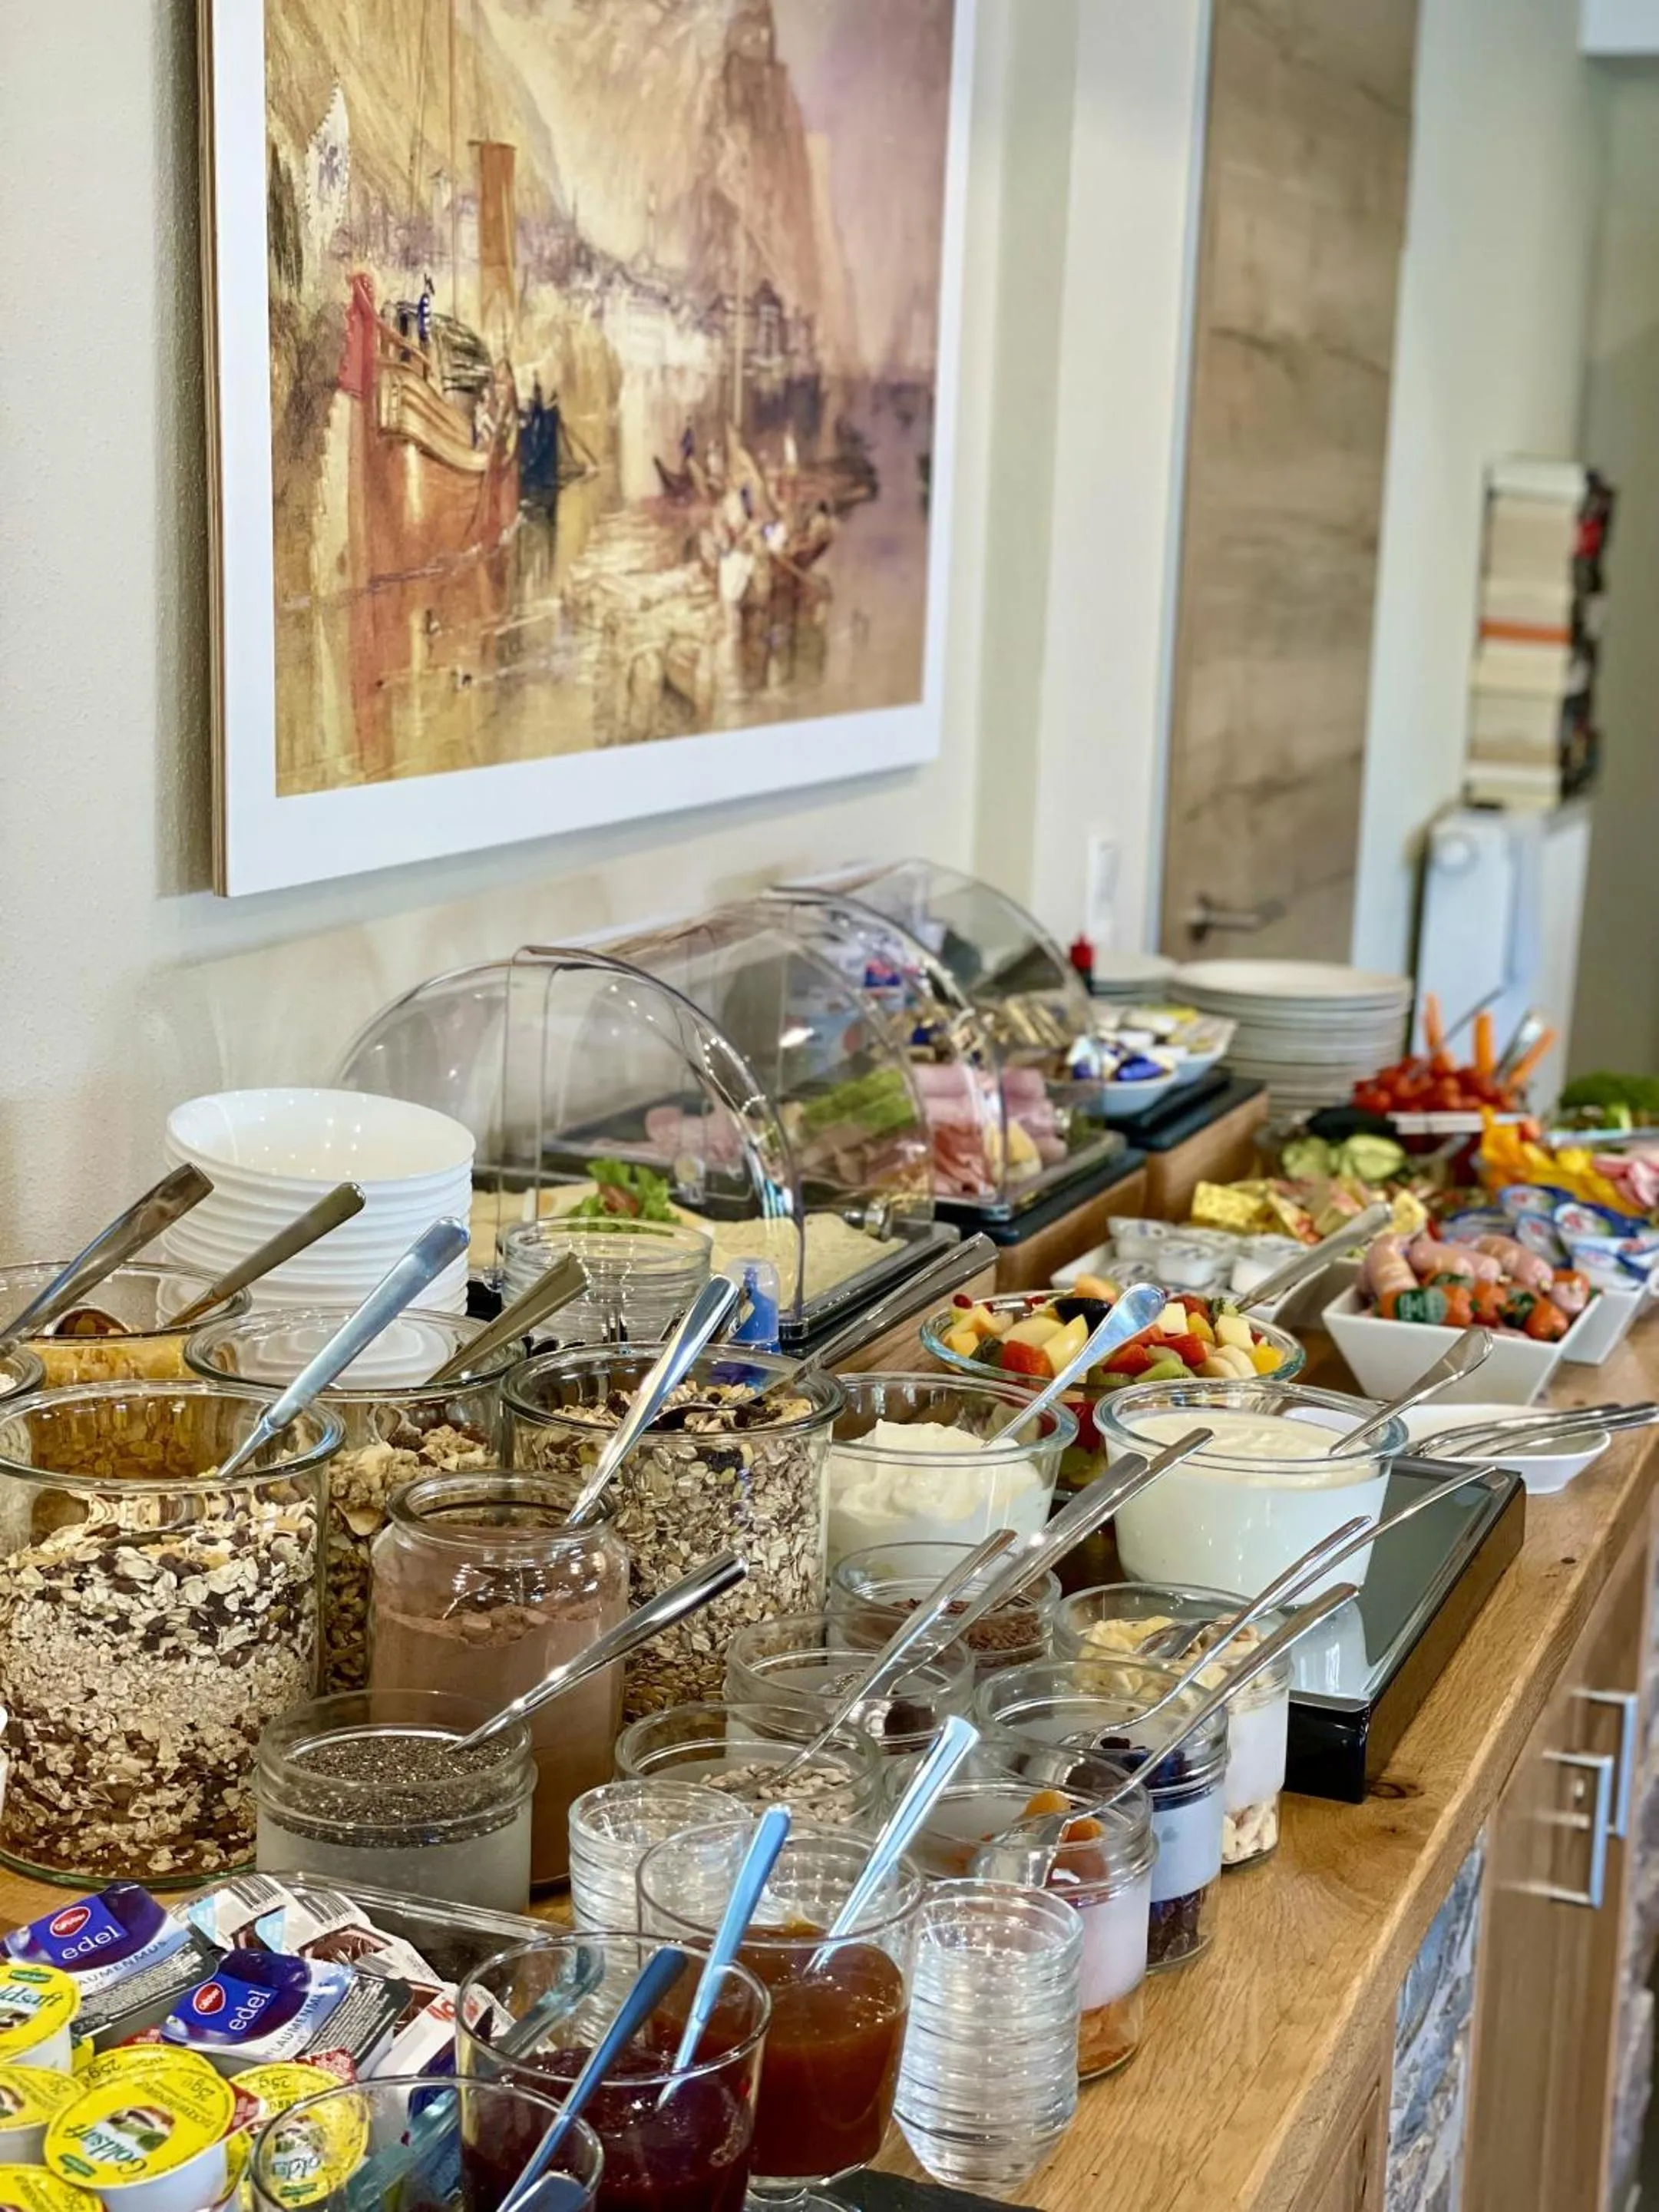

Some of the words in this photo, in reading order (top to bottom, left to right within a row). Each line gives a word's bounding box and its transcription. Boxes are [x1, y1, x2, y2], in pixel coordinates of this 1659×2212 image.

[61, 1926, 124, 1959] edel
[78, 1940, 167, 1986] AUMENMUS
[229, 1989, 271, 2032] edel
[63, 2124, 147, 2174] Goldsaft
